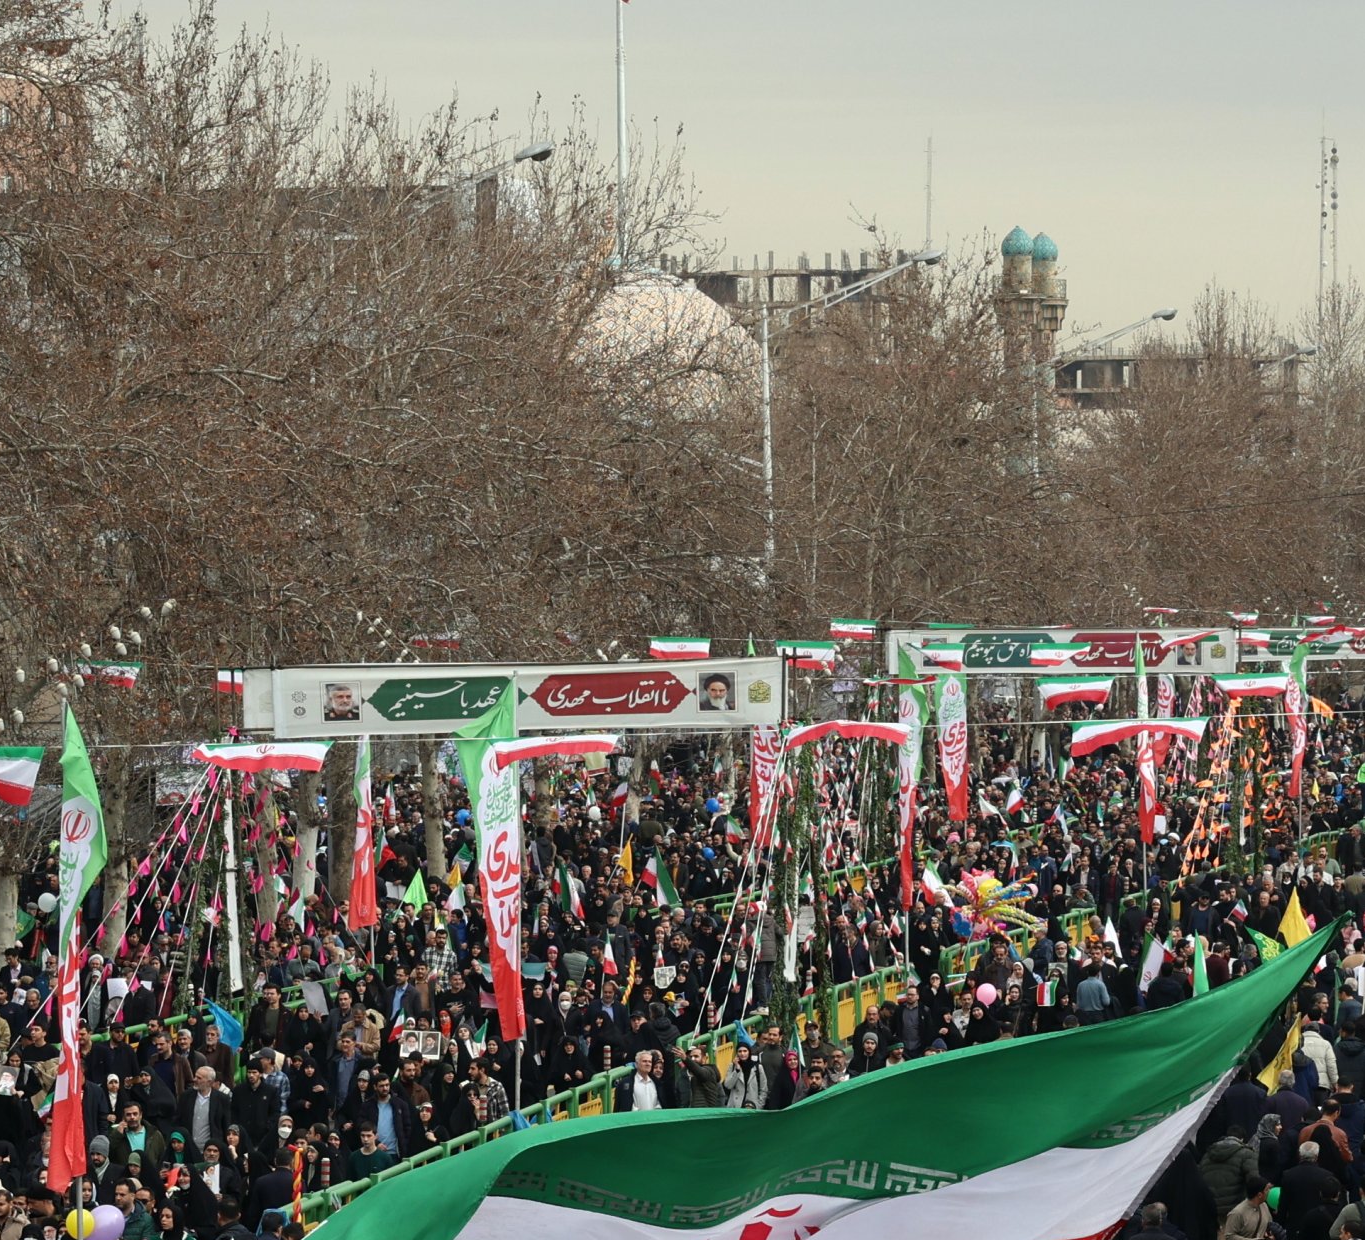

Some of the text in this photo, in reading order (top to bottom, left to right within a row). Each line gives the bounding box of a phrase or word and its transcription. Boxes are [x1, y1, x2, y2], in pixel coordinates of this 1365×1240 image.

[387, 680, 467, 718] حسینیم
[460, 689, 469, 716] با
[546, 679, 677, 713] تا انقلاب مهدی
